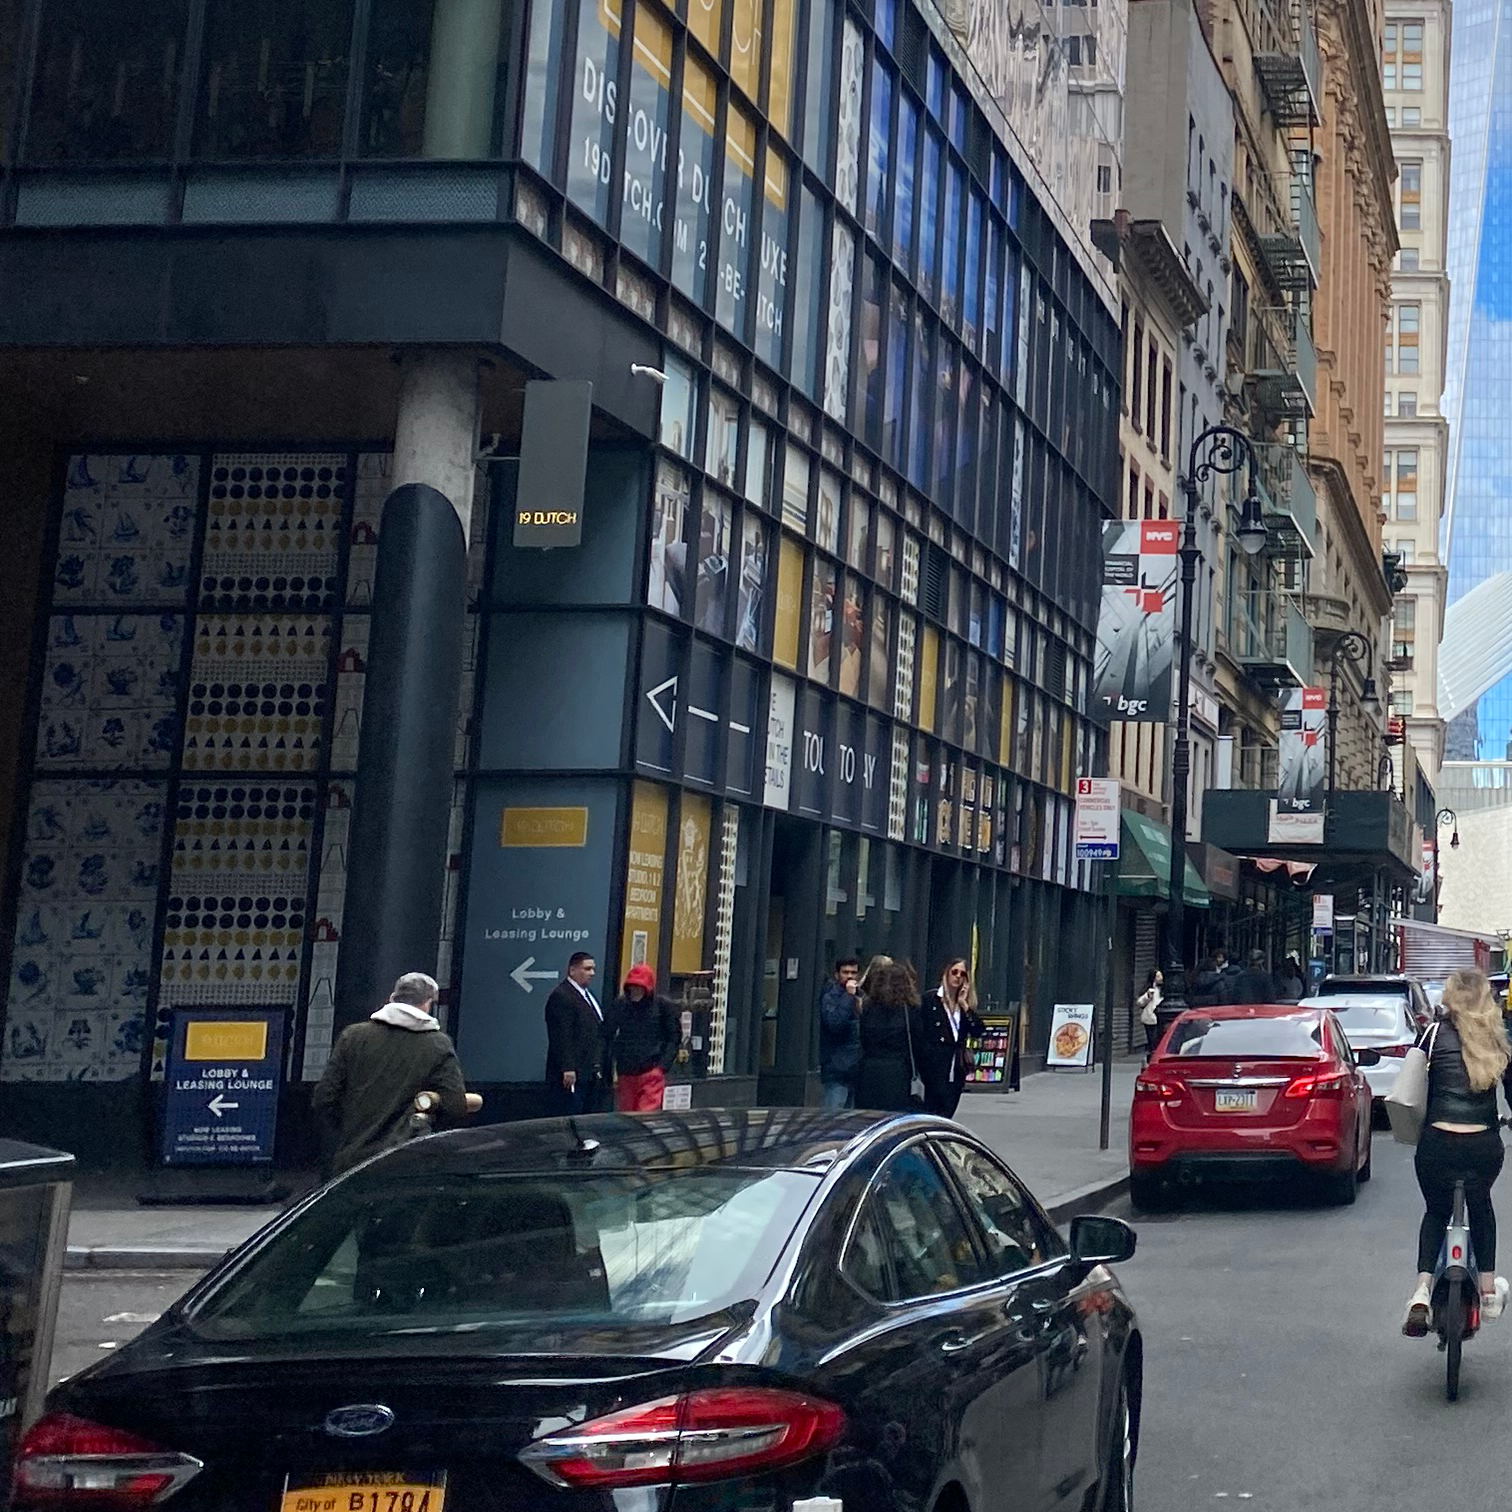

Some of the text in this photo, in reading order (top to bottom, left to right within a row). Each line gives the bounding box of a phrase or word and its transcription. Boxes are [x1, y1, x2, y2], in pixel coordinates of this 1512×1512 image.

[760, 230, 788, 287] UXE
[519, 512, 577, 525] 19 DUTCH
[1146, 531, 1173, 542] NYC
[1117, 695, 1148, 716] bgc
[1292, 797, 1311, 811] bgc
[512, 907, 565, 921] Lobby &
[485, 928, 590, 942] Leasing Lounge
[201, 1068, 249, 1079] LOBBY &
[176, 1079, 273, 1090] LEASING LOUNGE
[323, 1498, 337, 1510] of
